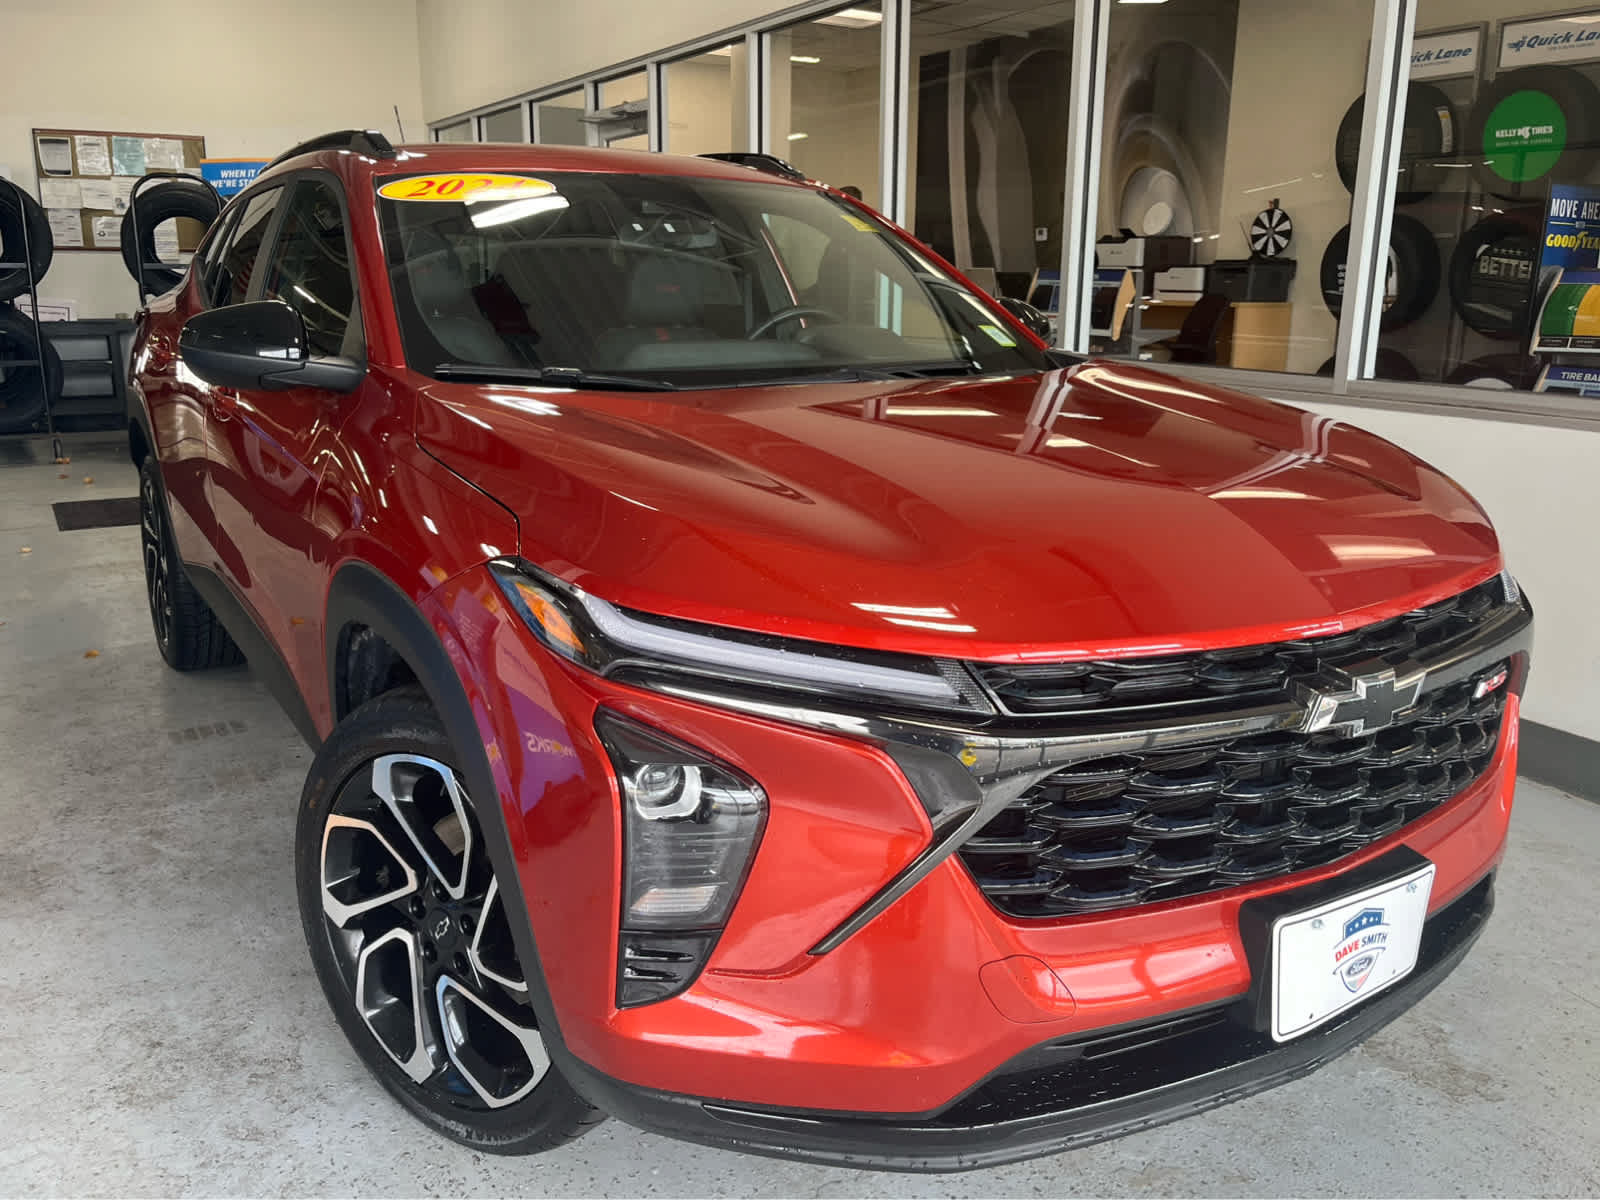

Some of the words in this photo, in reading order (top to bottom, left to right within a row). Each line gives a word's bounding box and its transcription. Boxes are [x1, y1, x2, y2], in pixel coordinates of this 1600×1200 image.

[1527, 32, 1573, 48] Quick
[1411, 50, 1433, 63] uick
[1434, 47, 1472, 60] Lane
[220, 169, 247, 178] WHEN
[248, 168, 257, 178] IT
[1550, 198, 1579, 218] MOVE
[1560, 371, 1584, 381] TIRE
[1335, 939, 1361, 962] DAVE
[1361, 932, 1388, 948] SMITH
